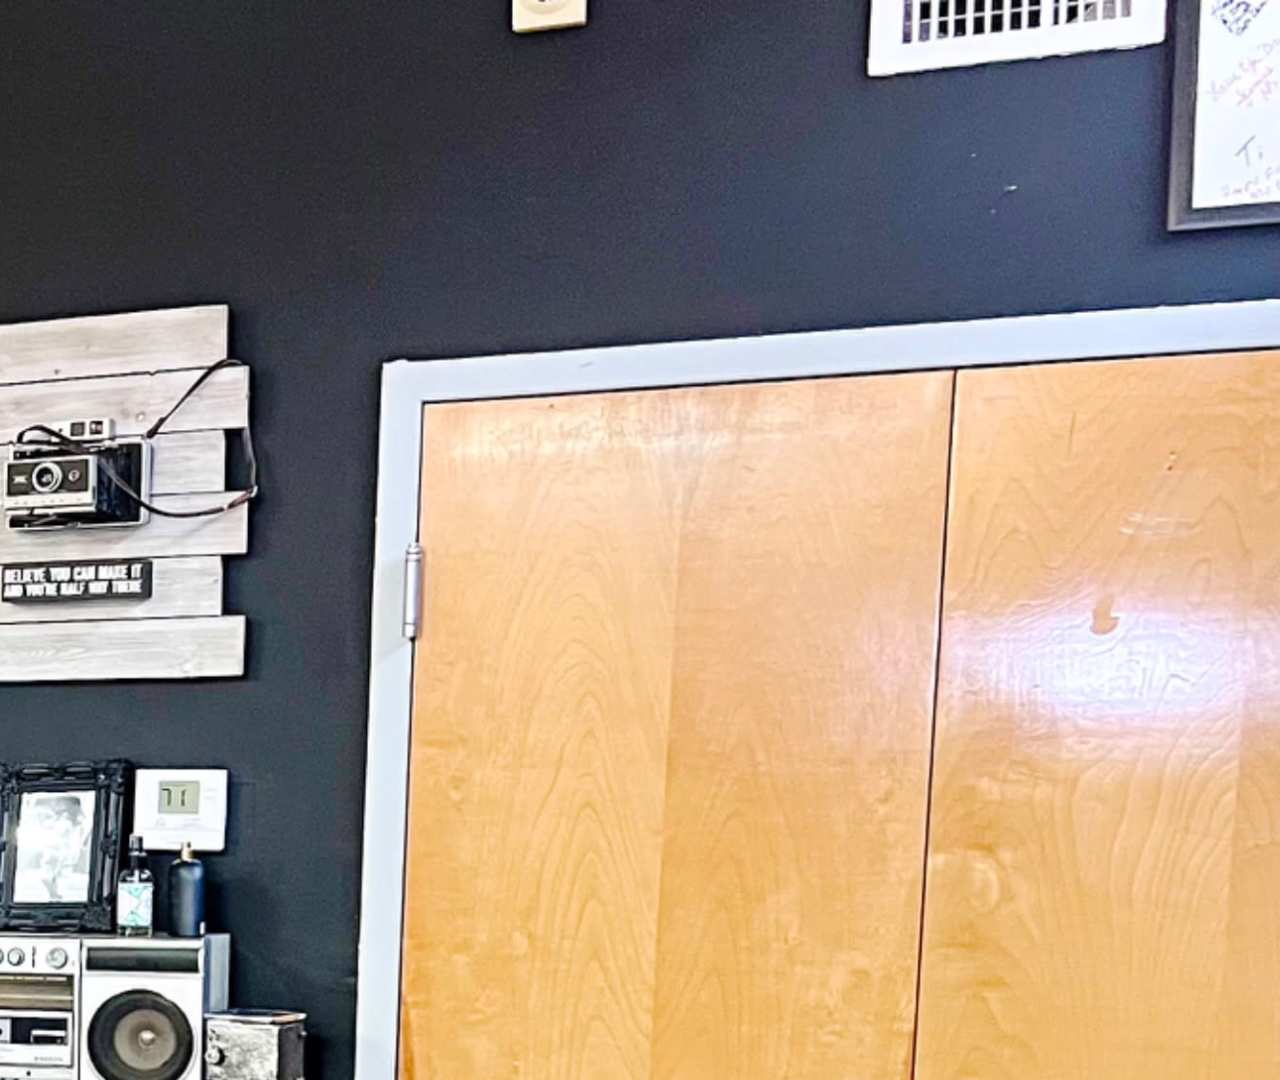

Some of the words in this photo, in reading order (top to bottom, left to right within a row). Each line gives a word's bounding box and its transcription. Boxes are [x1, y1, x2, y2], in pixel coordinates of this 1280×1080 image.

[5, 568, 47, 583] BELIEVE
[50, 567, 71, 581] YOU
[73, 565, 96, 580] CAN
[98, 564, 129, 580] MAKE
[130, 563, 143, 578] IT
[4, 584, 23, 598] AND
[60, 581, 86, 595] HALF
[111, 579, 143, 594] THERE
